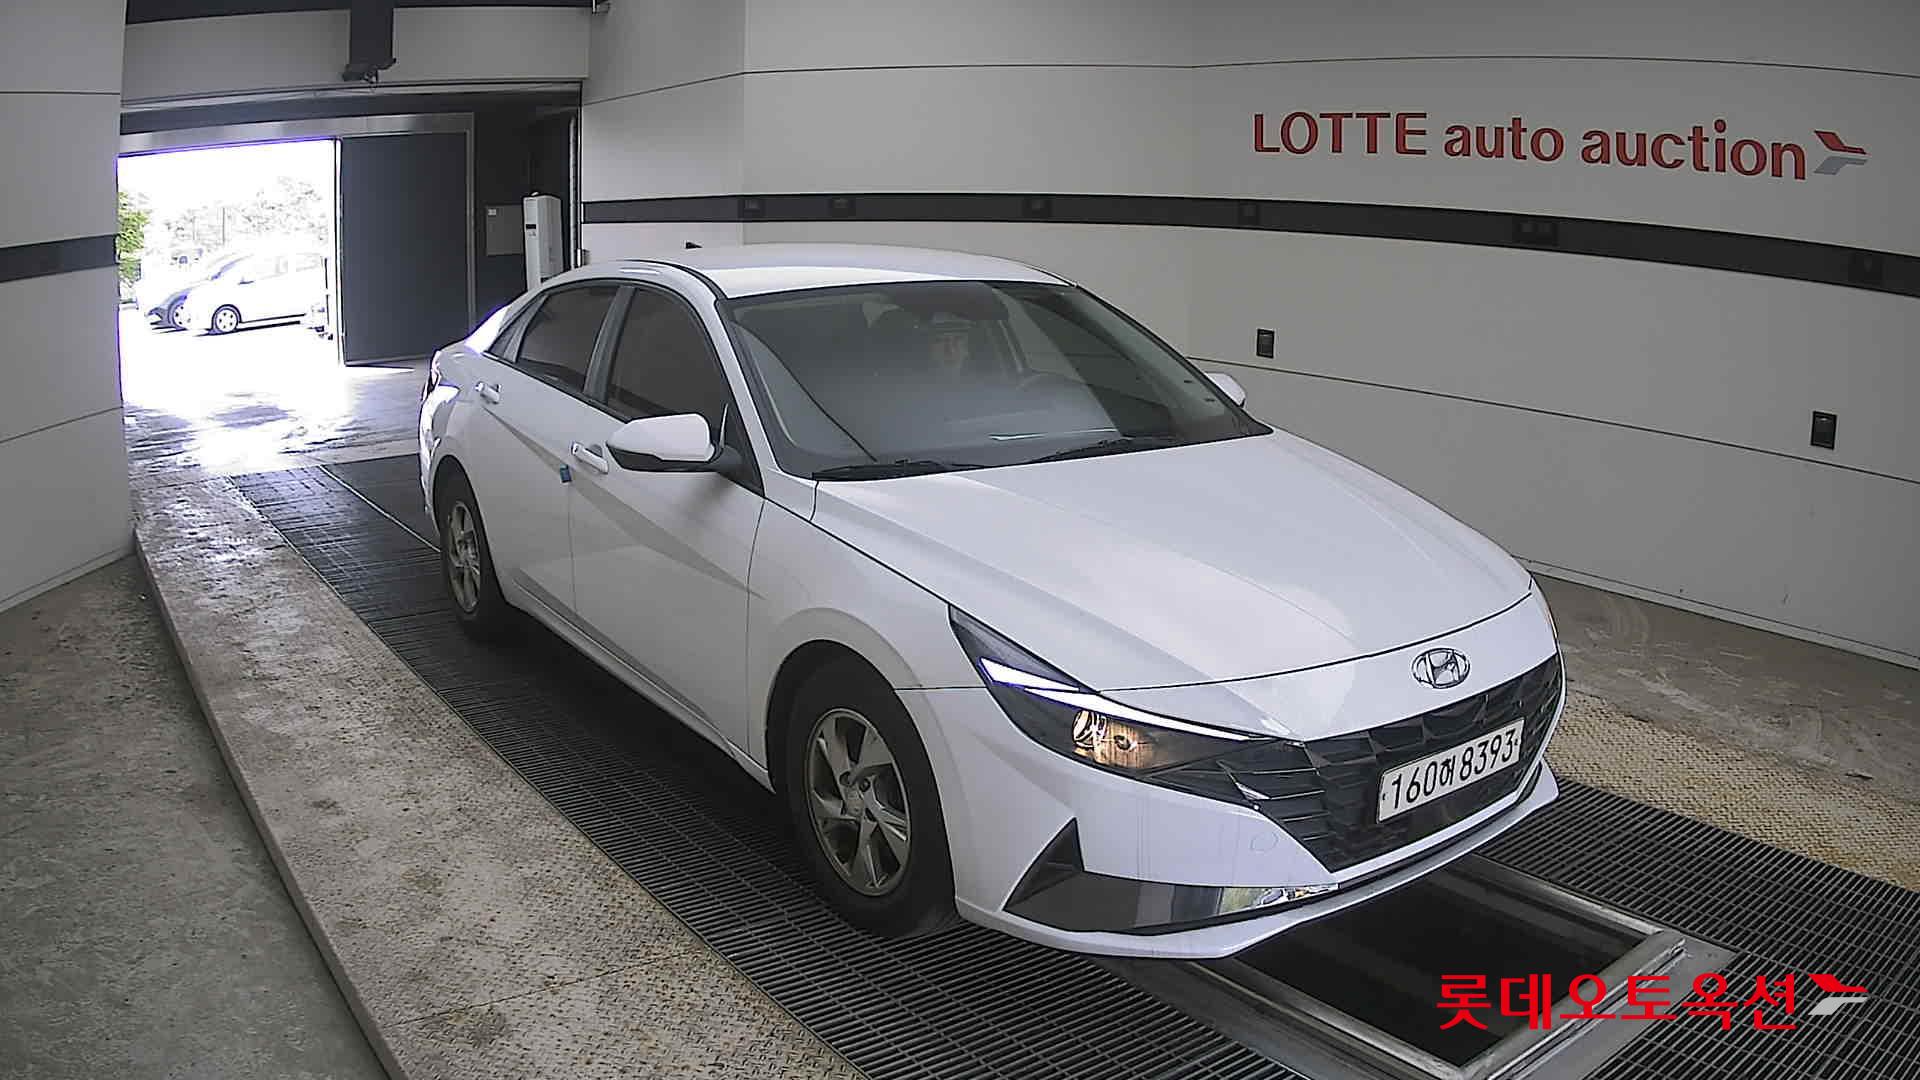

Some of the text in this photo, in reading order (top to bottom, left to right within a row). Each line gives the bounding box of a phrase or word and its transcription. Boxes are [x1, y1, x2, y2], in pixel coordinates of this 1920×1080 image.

[1254, 111, 1806, 180] LOTTE auto auction
